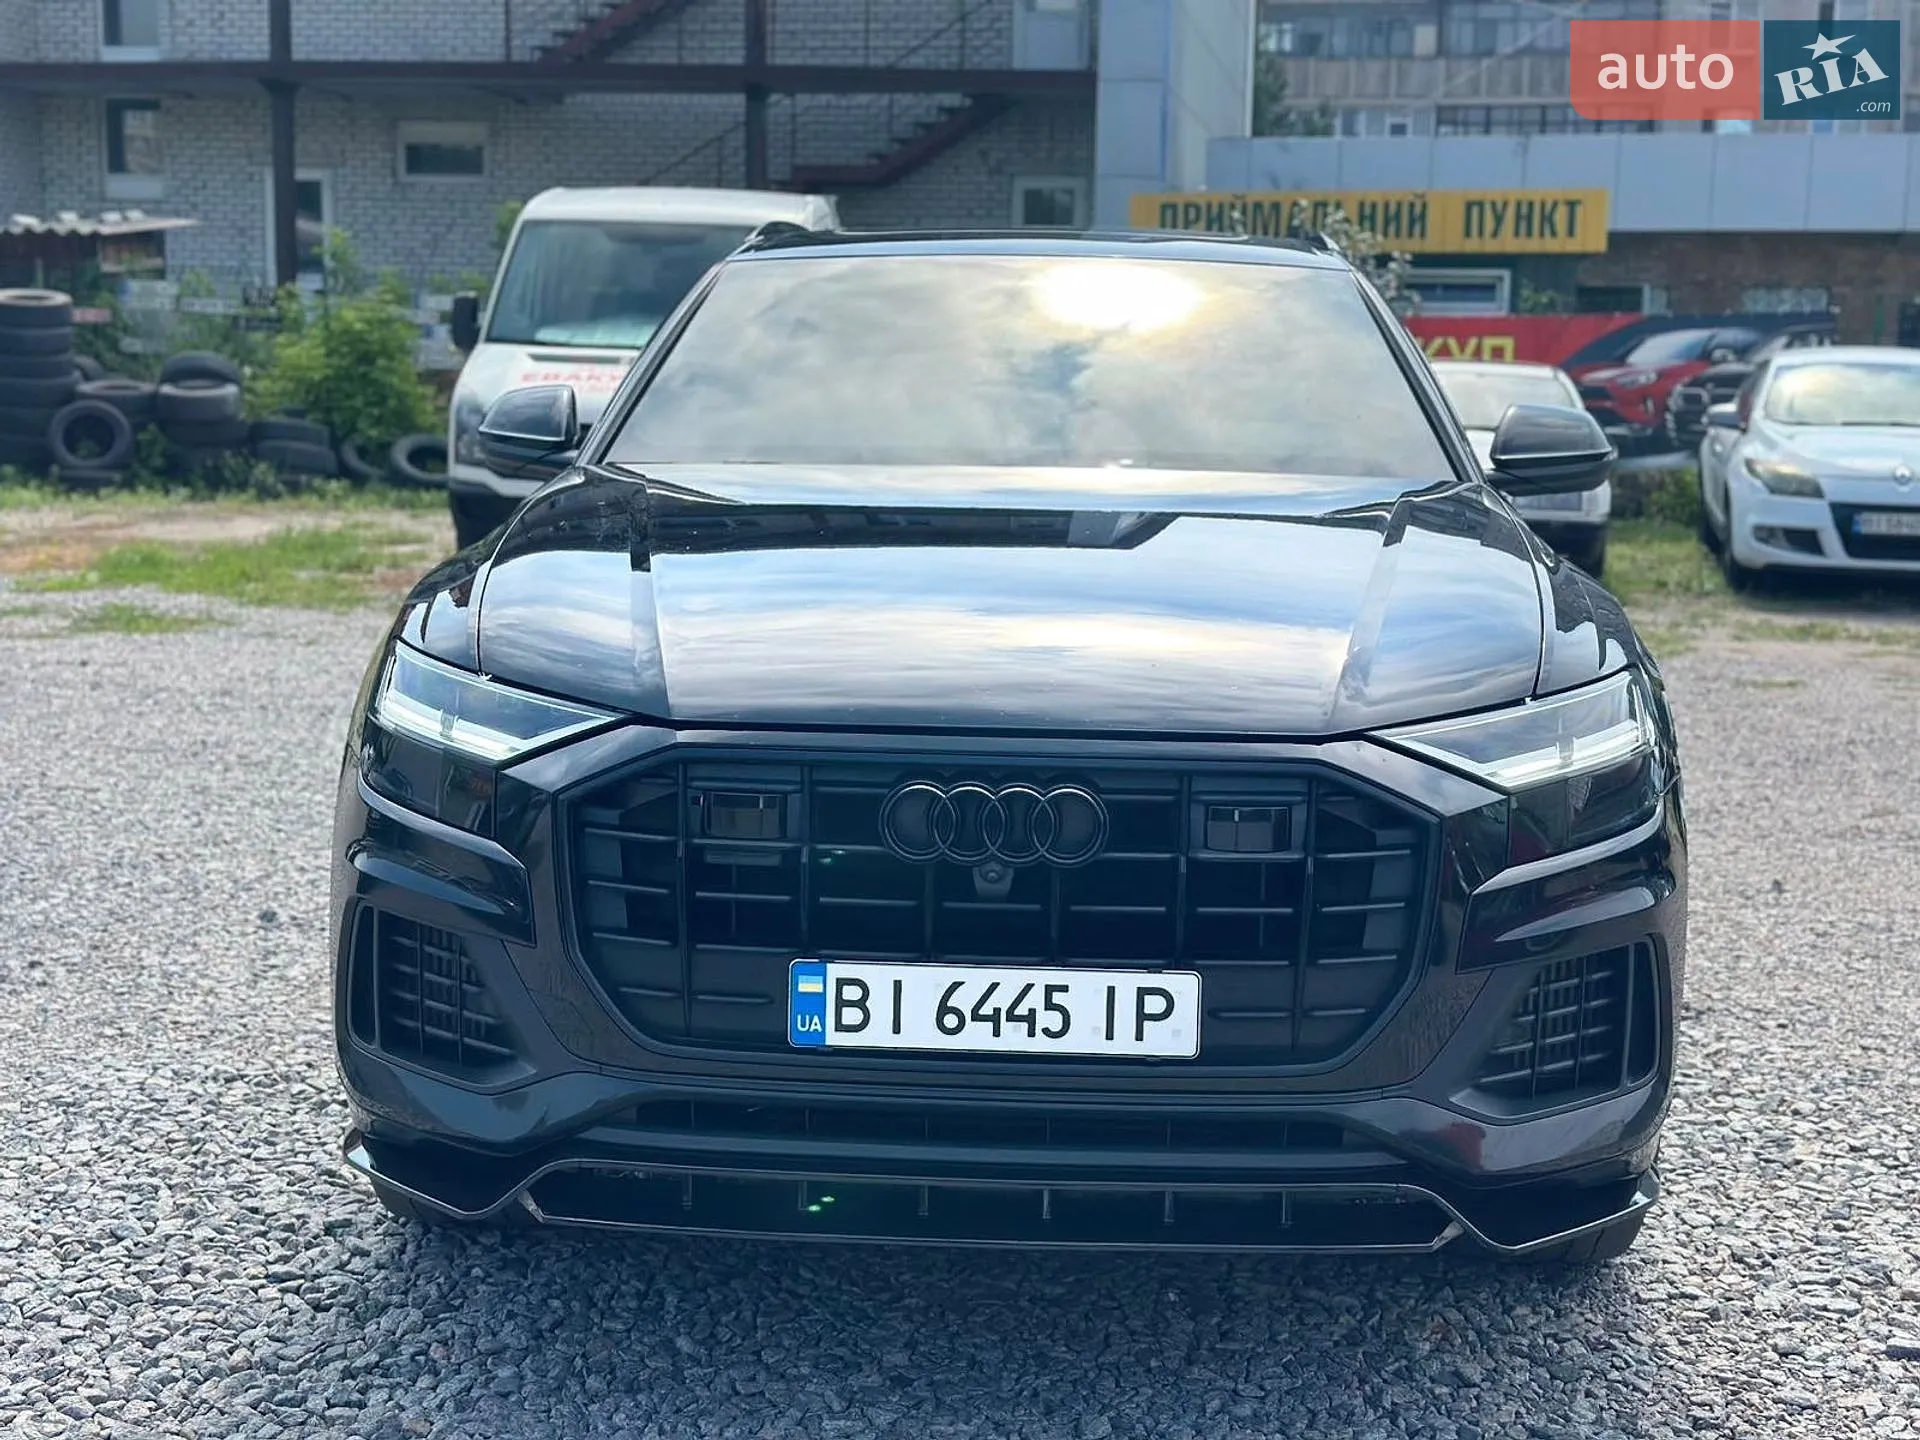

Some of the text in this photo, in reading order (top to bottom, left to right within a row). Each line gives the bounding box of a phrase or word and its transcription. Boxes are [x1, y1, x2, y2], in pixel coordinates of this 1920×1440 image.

[1464, 199, 1582, 240] ПУНКТ
[797, 1014, 822, 1032] UA
[834, 977, 1175, 1042] BI 6445 IP
